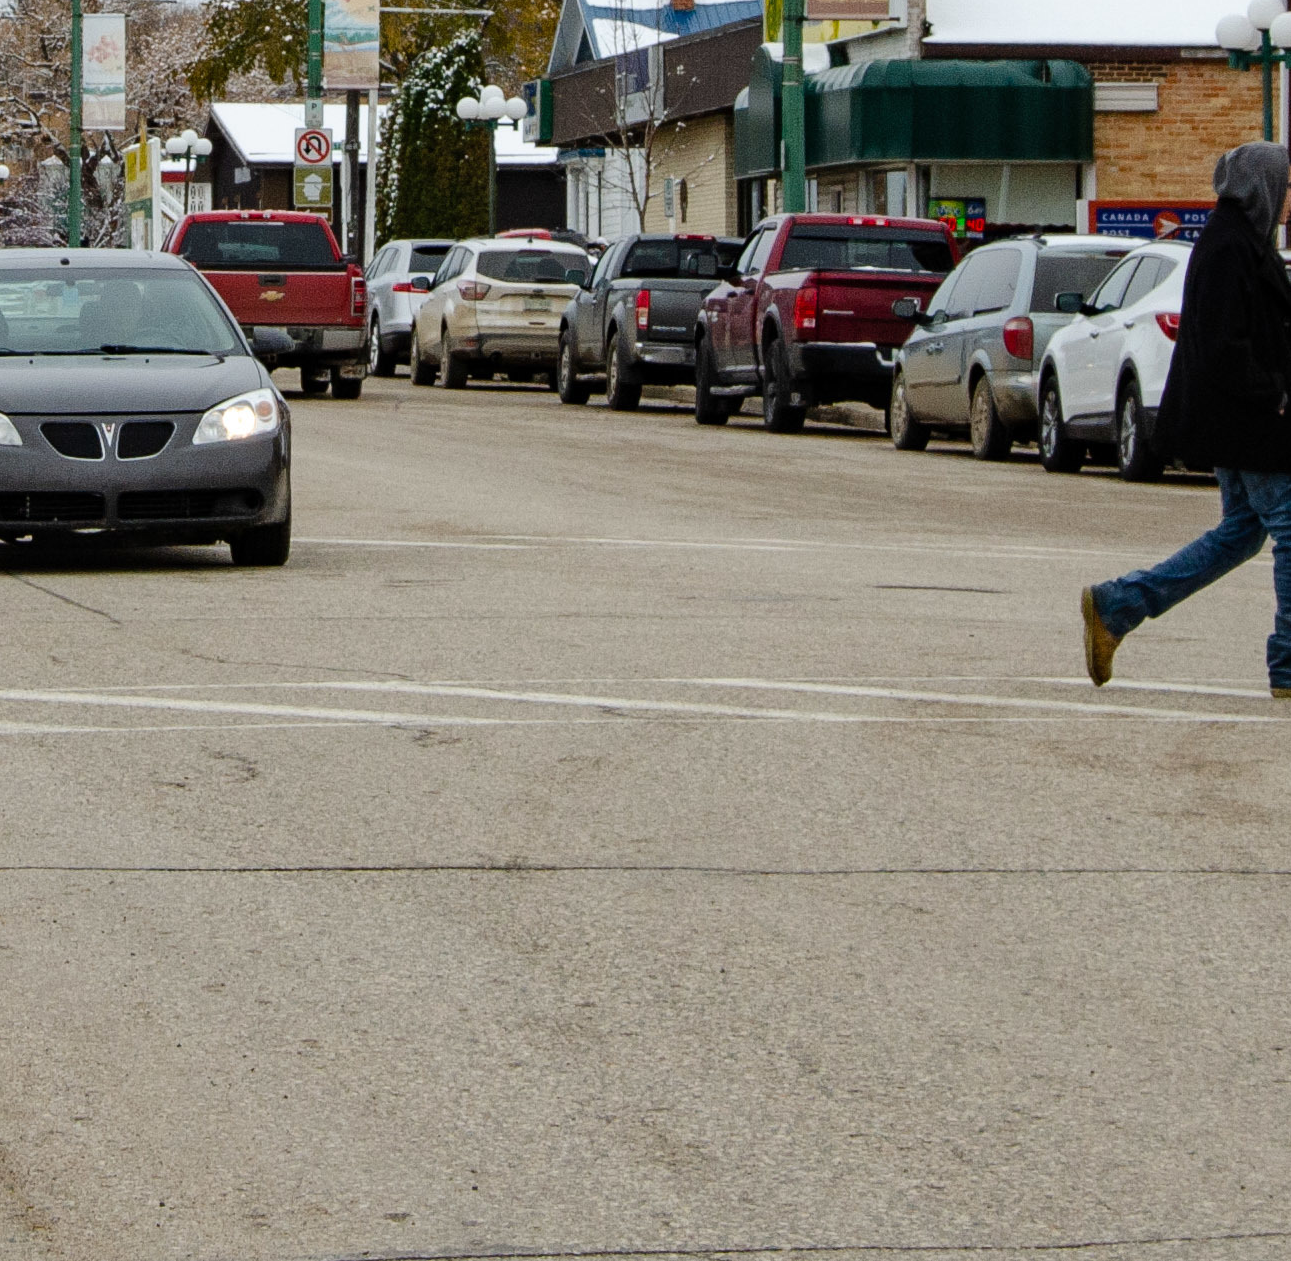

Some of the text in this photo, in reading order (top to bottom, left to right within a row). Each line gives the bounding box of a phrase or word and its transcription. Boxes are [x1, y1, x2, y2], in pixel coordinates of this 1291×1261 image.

[1102, 213, 1206, 222] CANADA POS
[1102, 229, 1130, 237] POST
